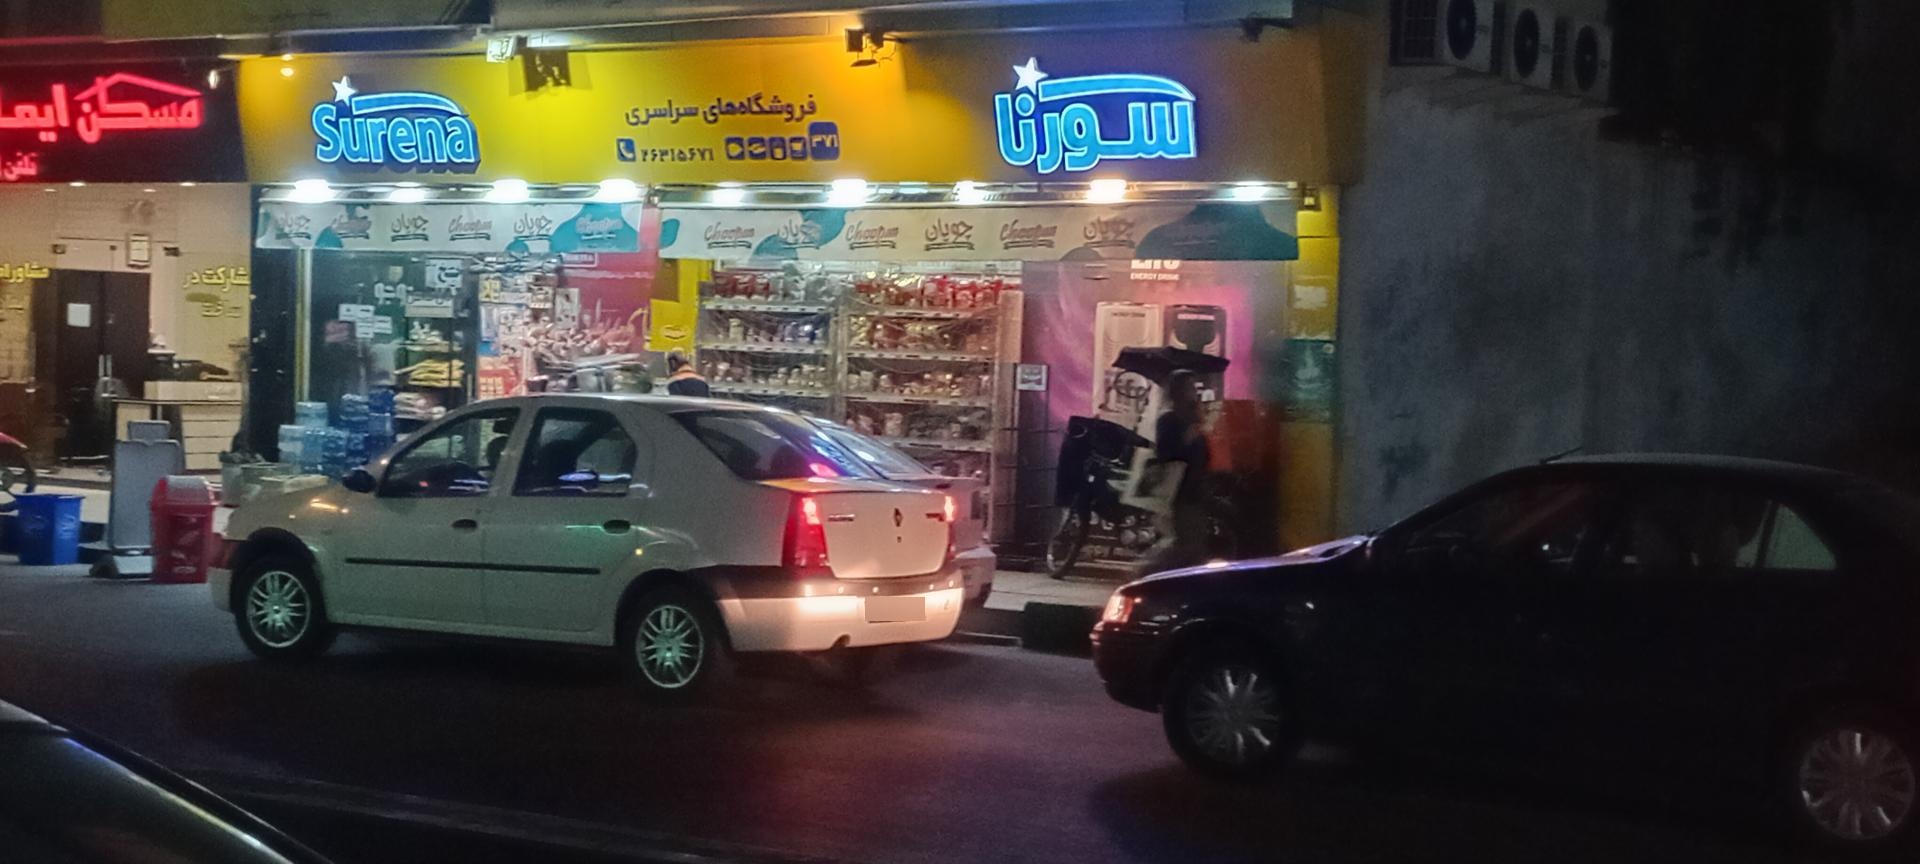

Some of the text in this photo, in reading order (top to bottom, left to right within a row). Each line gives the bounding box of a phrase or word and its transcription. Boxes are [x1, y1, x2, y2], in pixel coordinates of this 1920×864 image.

[0, 73, 204, 143] مسکن ایم
[311, 97, 480, 169] Surena
[625, 99, 699, 125] سراسری
[995, 86, 1196, 174] سورنا
[3, 151, 39, 181] تلفن
[200, 265, 251, 292] شارکت
